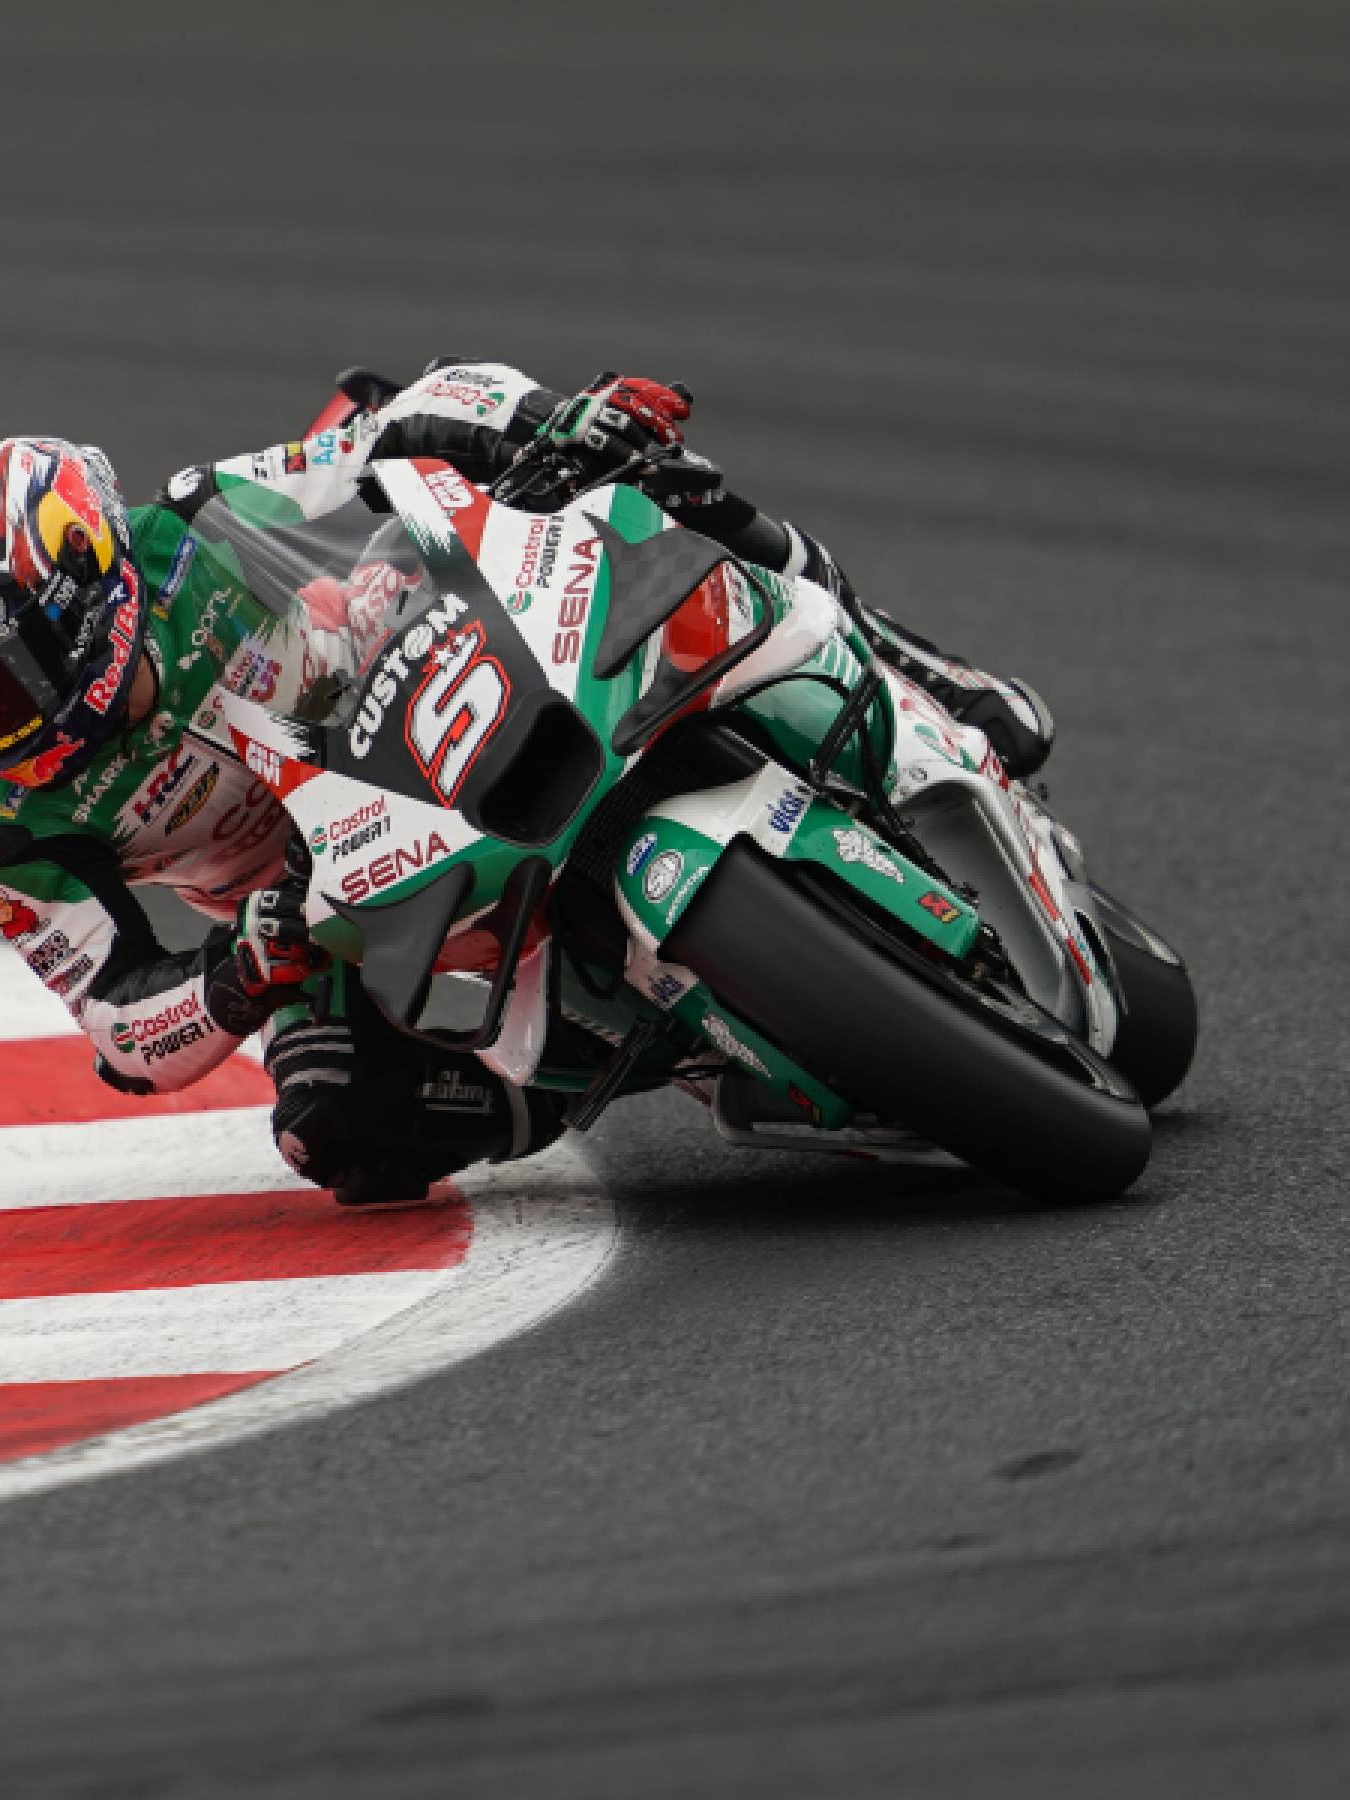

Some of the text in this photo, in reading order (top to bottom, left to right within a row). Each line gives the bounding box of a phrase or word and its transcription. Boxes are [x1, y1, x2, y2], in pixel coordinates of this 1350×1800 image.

[514, 518, 546, 588] Castrol
[536, 526, 562, 590] POWER
[552, 534, 603, 665] SENA
[83, 627, 134, 715] Red
[348, 591, 470, 760] CUSTOM
[404, 620, 512, 809] 5
[70, 753, 129, 825] SHARK
[130, 743, 195, 826] HRC
[328, 794, 388, 841] Castrol
[331, 818, 382, 864] POWER
[340, 830, 451, 905] SENA
[129, 991, 202, 1041] Castrol
[140, 1013, 215, 1066] POWER 1
